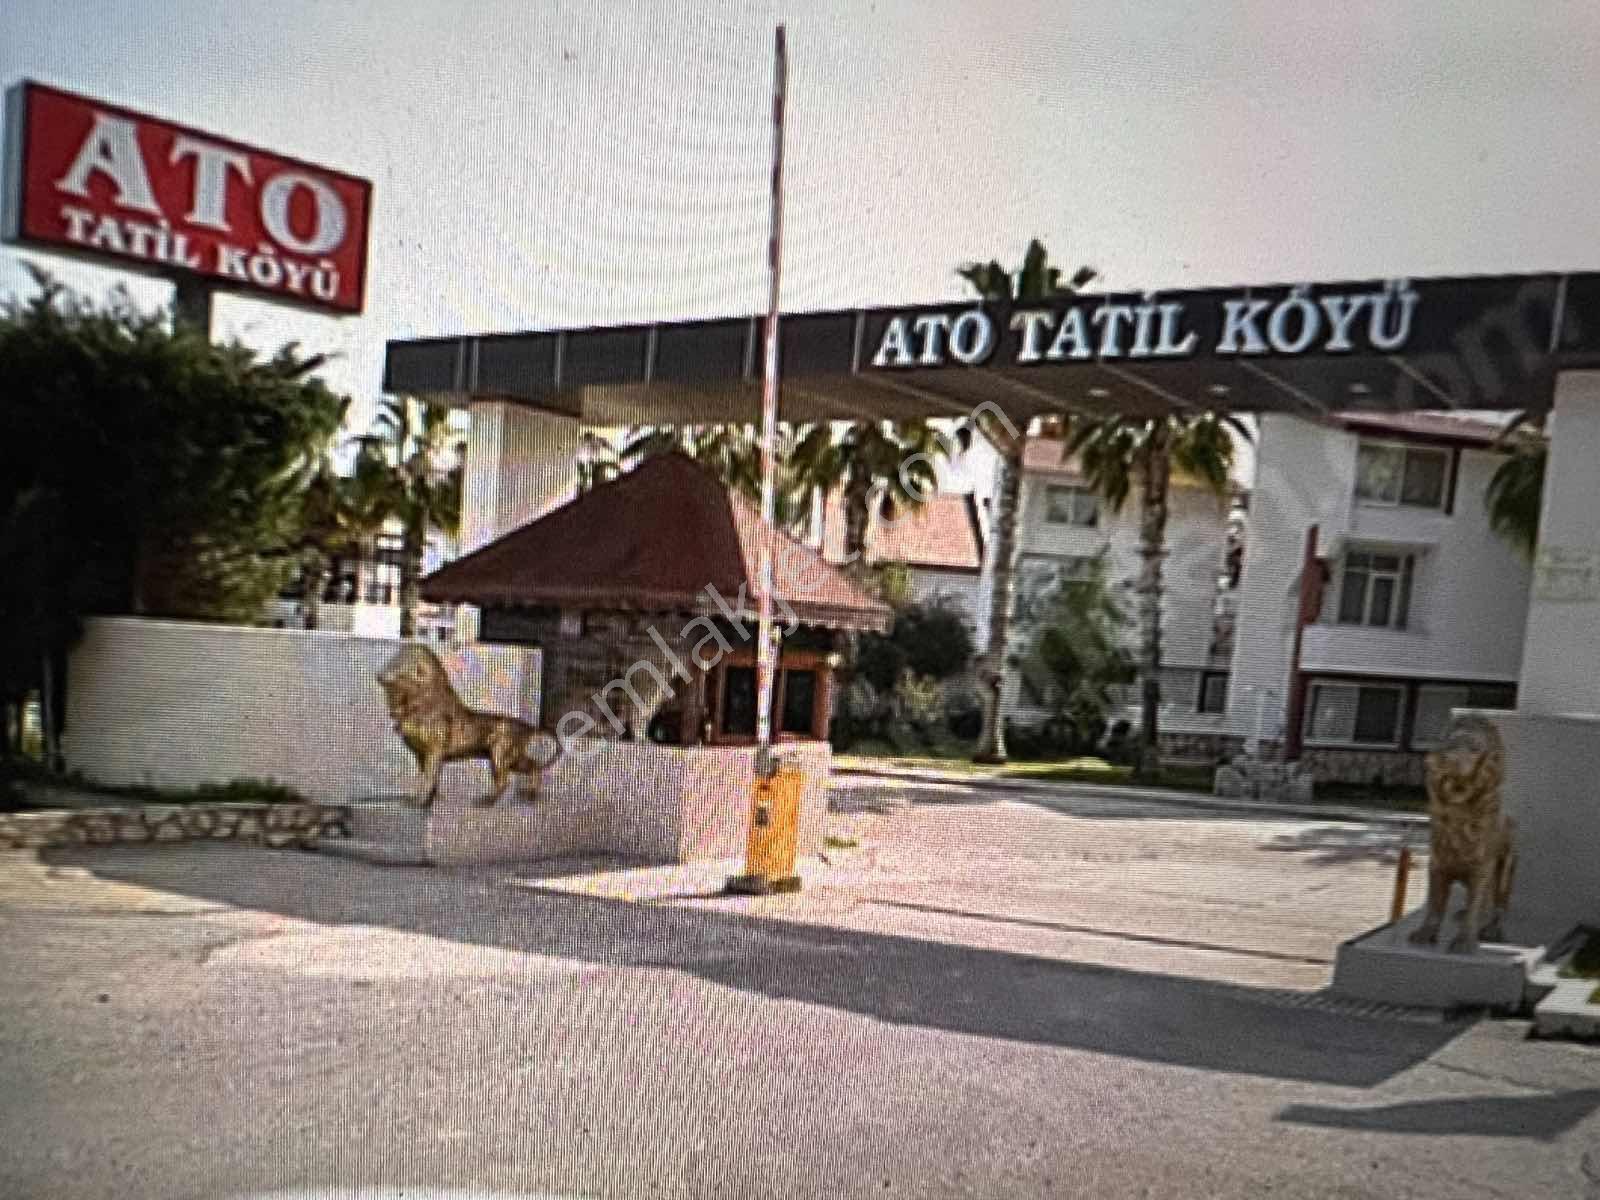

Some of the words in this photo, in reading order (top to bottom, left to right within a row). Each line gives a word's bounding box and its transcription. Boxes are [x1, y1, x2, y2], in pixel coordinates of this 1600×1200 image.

[53, 112, 347, 256] ATO
[61, 203, 201, 267] TATİL
[216, 243, 340, 299] KÖYÜ
[872, 309, 992, 366] ATO
[1009, 294, 1198, 363] TATİL
[1215, 281, 1419, 354] KÖYÜ
